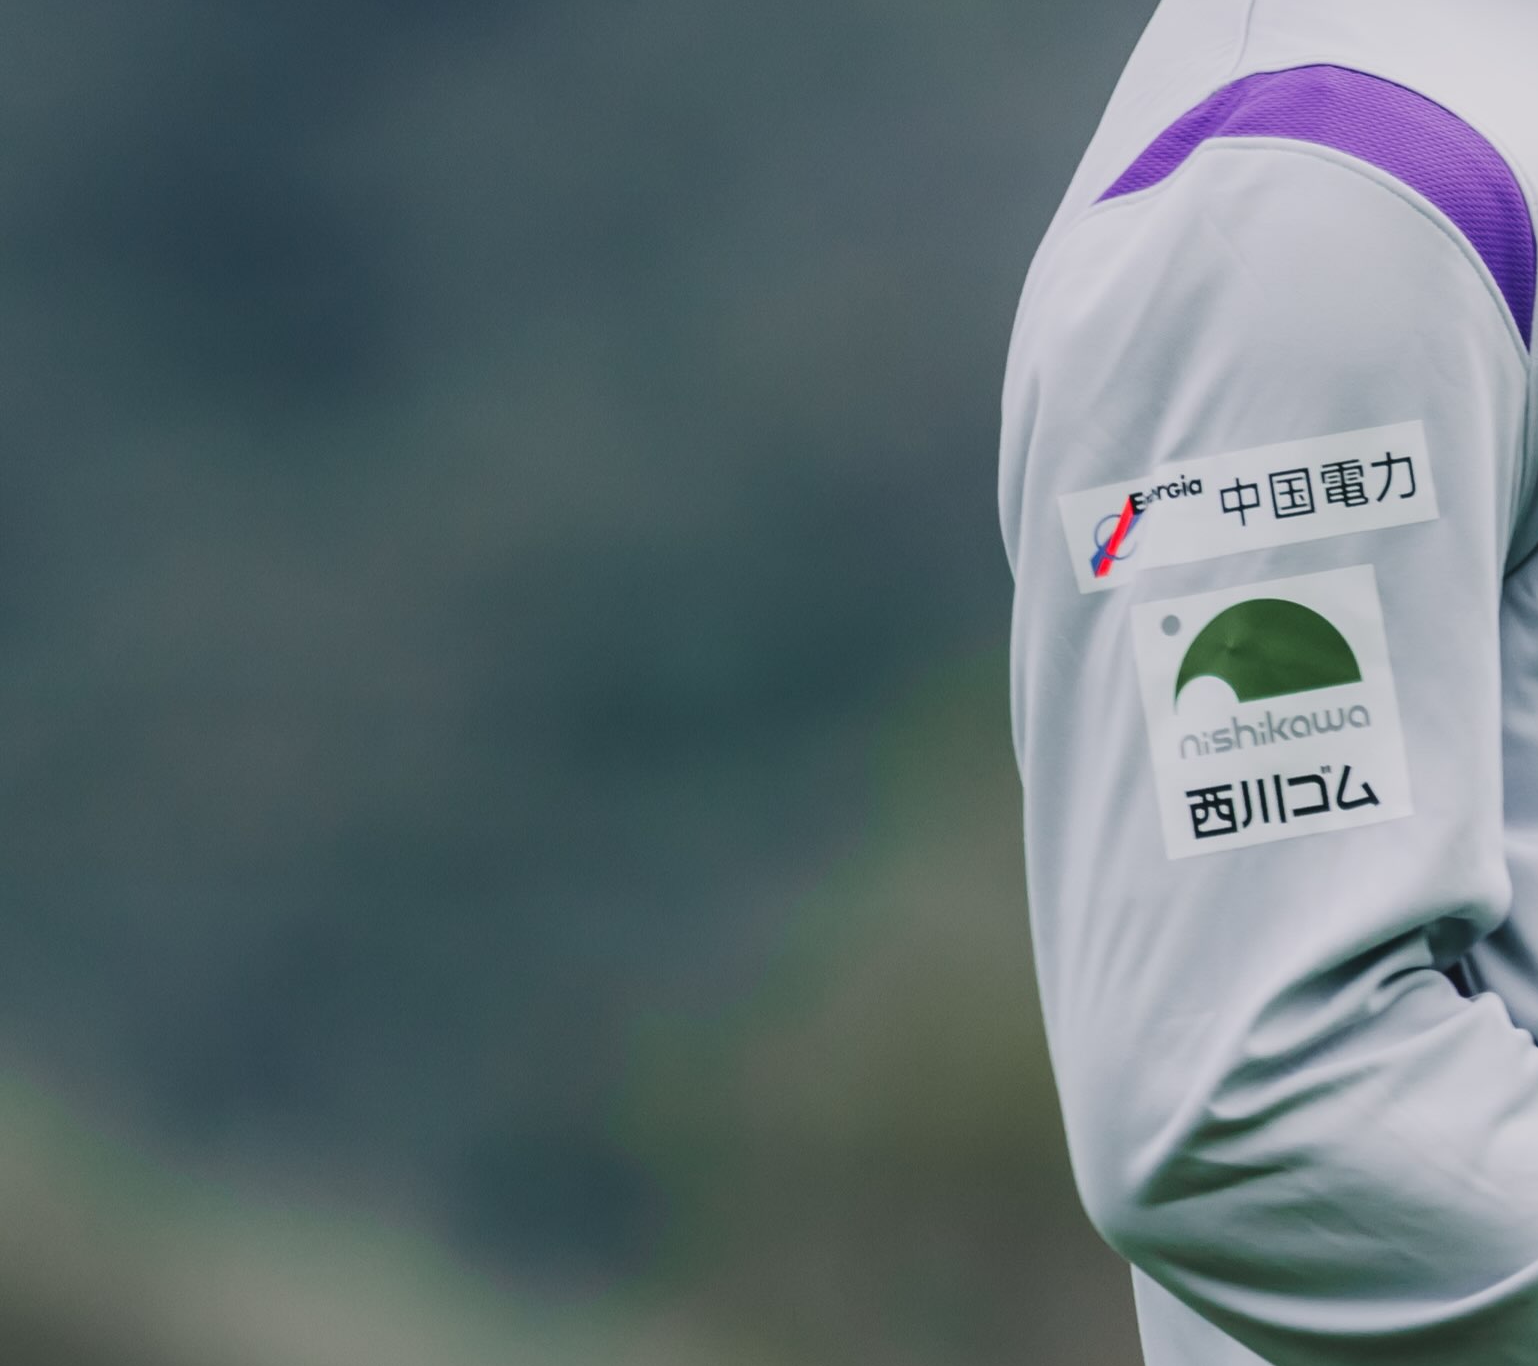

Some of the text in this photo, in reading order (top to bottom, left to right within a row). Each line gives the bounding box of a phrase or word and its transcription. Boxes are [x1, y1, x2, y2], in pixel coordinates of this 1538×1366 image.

[1220, 451, 1416, 527] 中国電力
[1179, 704, 1372, 760] nishikawa
[1185, 764, 1380, 840] 西川ゴム
